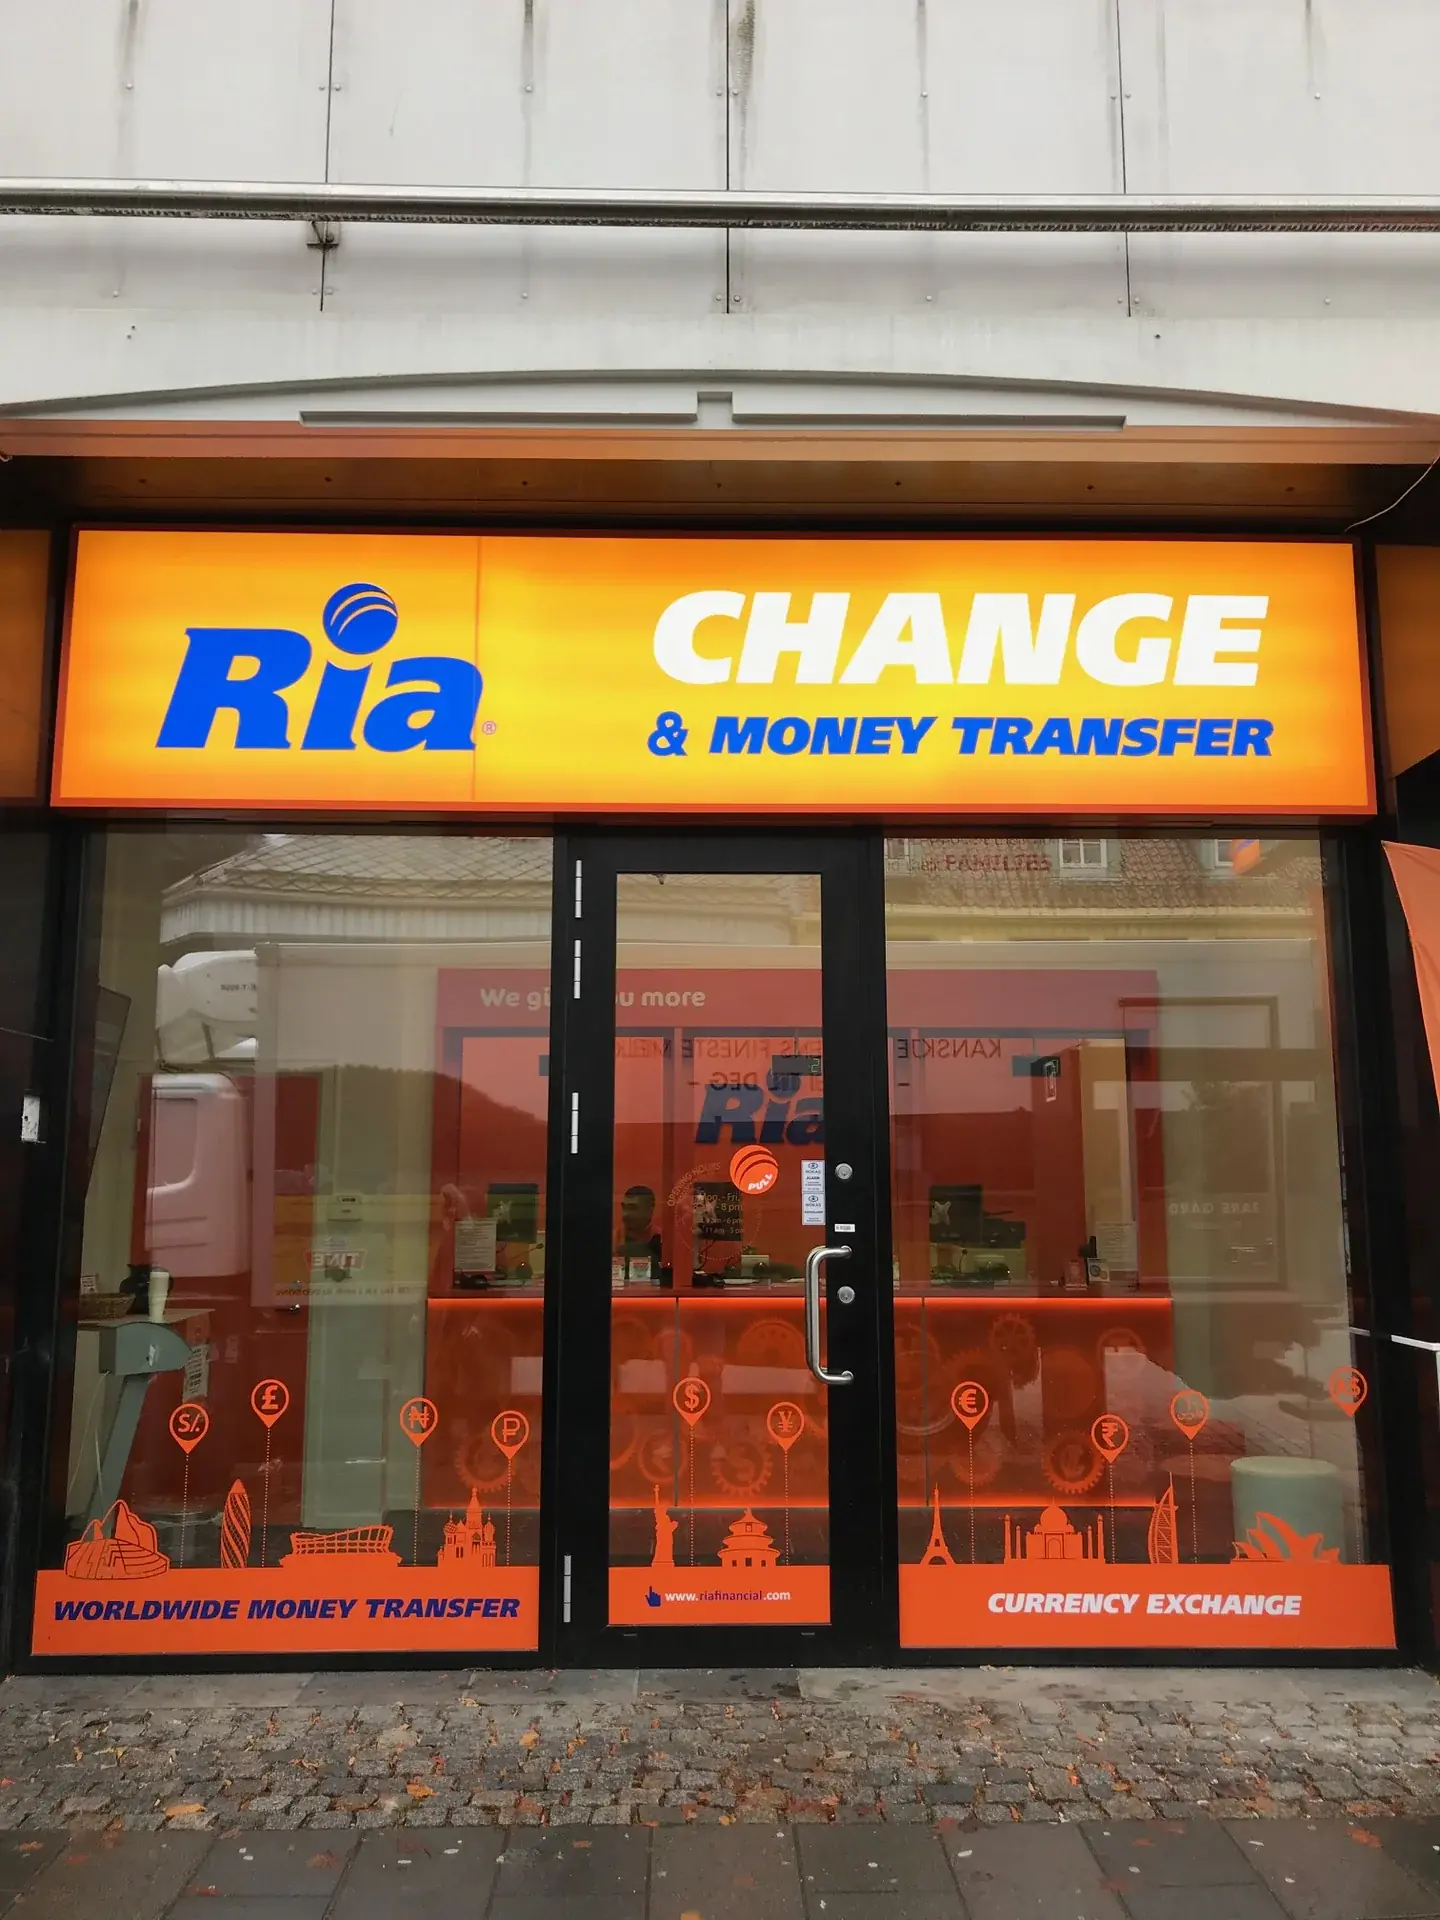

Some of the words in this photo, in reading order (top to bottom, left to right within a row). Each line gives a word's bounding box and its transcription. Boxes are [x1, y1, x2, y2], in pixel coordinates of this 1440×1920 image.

[653, 590, 1269, 686] CHANGE
[155, 582, 484, 752] Ria
[647, 711, 688, 757] &
[709, 716, 937, 755] MONEY
[951, 718, 1274, 757] TRANSFER
[480, 988, 520, 1007] We
[641, 991, 706, 1007] more
[747, 1172, 773, 1190] PULL
[665, 1590, 791, 1602] www.riafinancial.com
[988, 1593, 1140, 1615] CURRENCY
[1146, 1593, 1302, 1616] EXCHANGE
[54, 1600, 240, 1621] WORLDWIDE
[247, 1599, 356, 1619] MONEY
[366, 1598, 520, 1619] TRANSFER
